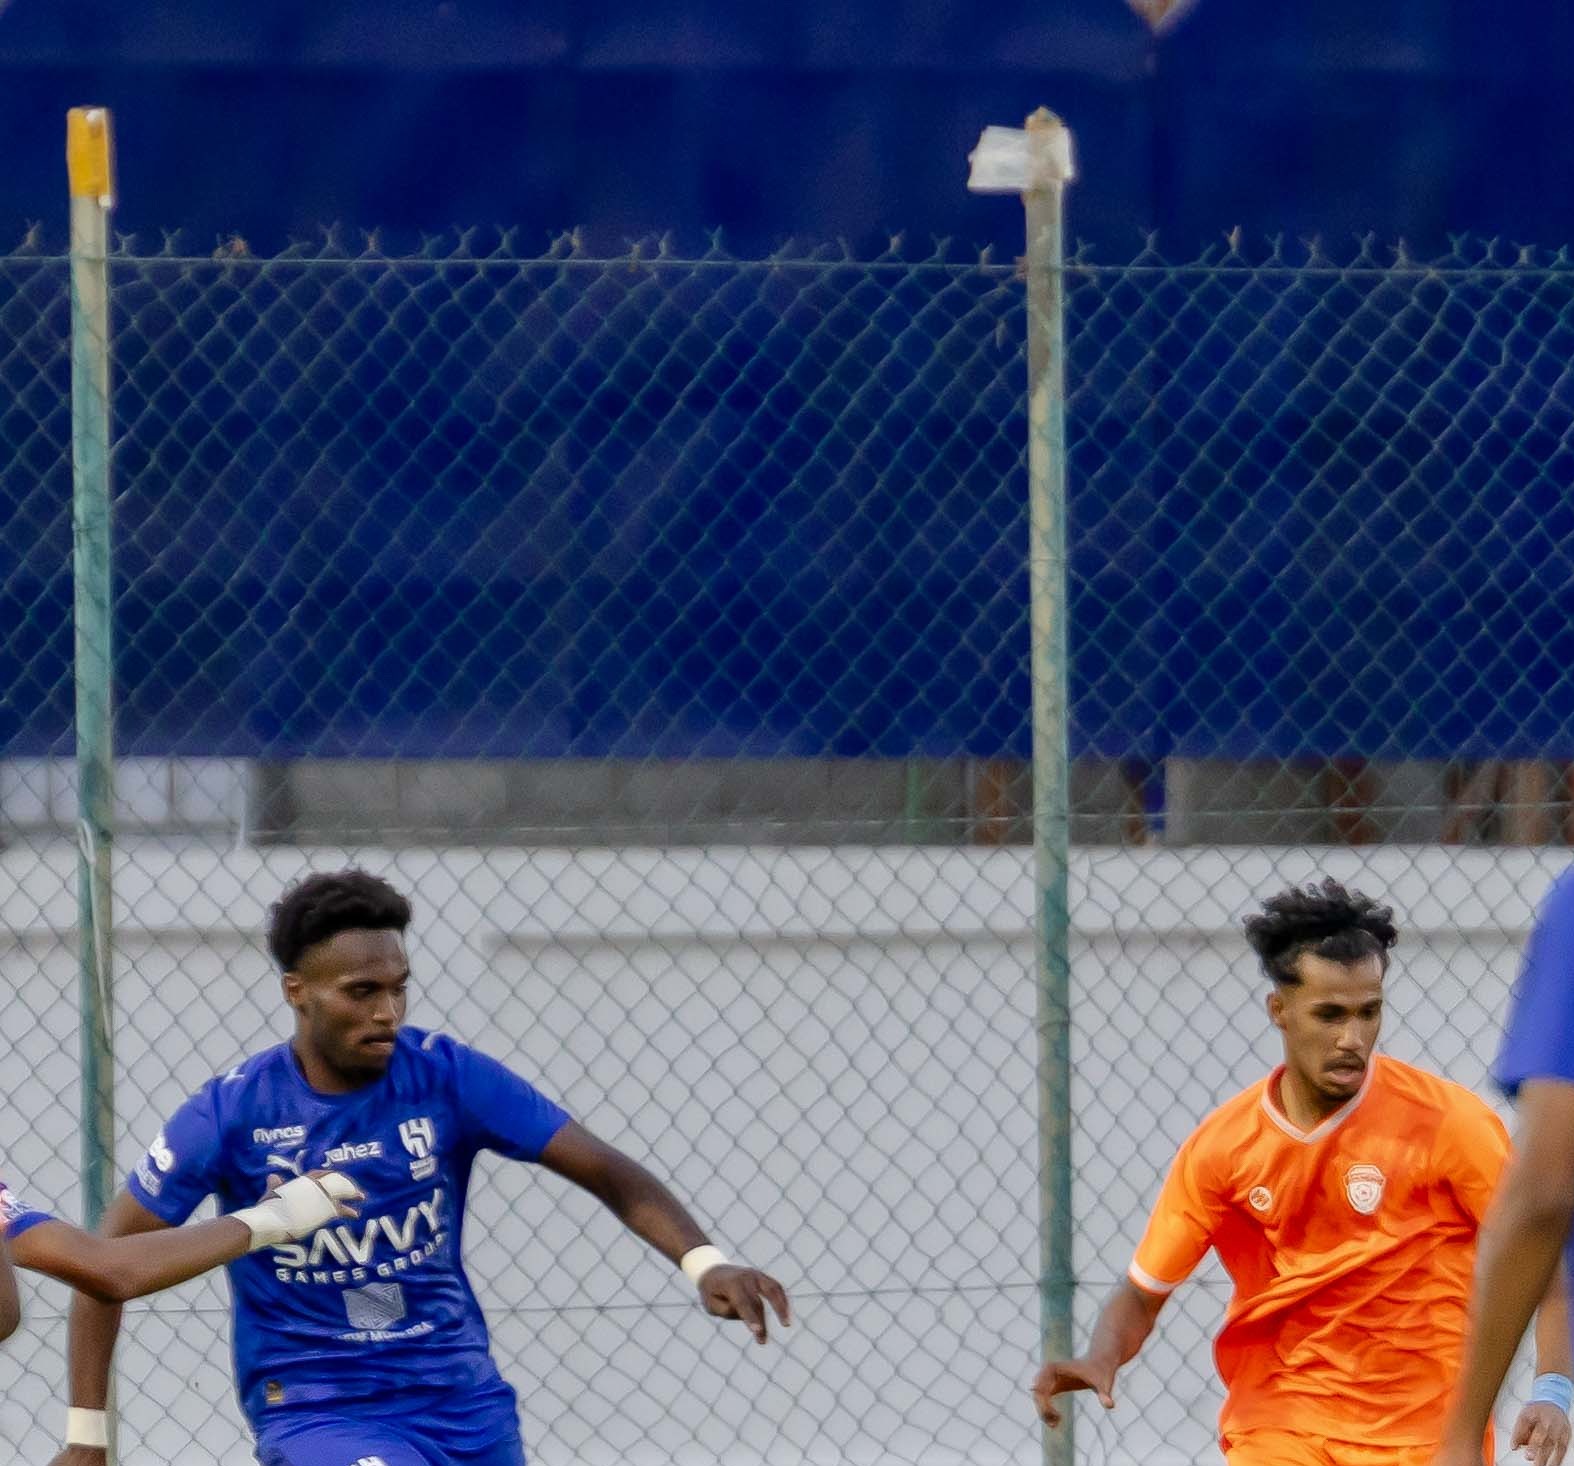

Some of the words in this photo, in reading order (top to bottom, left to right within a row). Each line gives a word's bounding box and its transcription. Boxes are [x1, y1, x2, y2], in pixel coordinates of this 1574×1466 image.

[321, 1141, 382, 1169] jahez
[271, 1187, 444, 1267] SAVVY
[275, 1267, 367, 1284] GAMES
